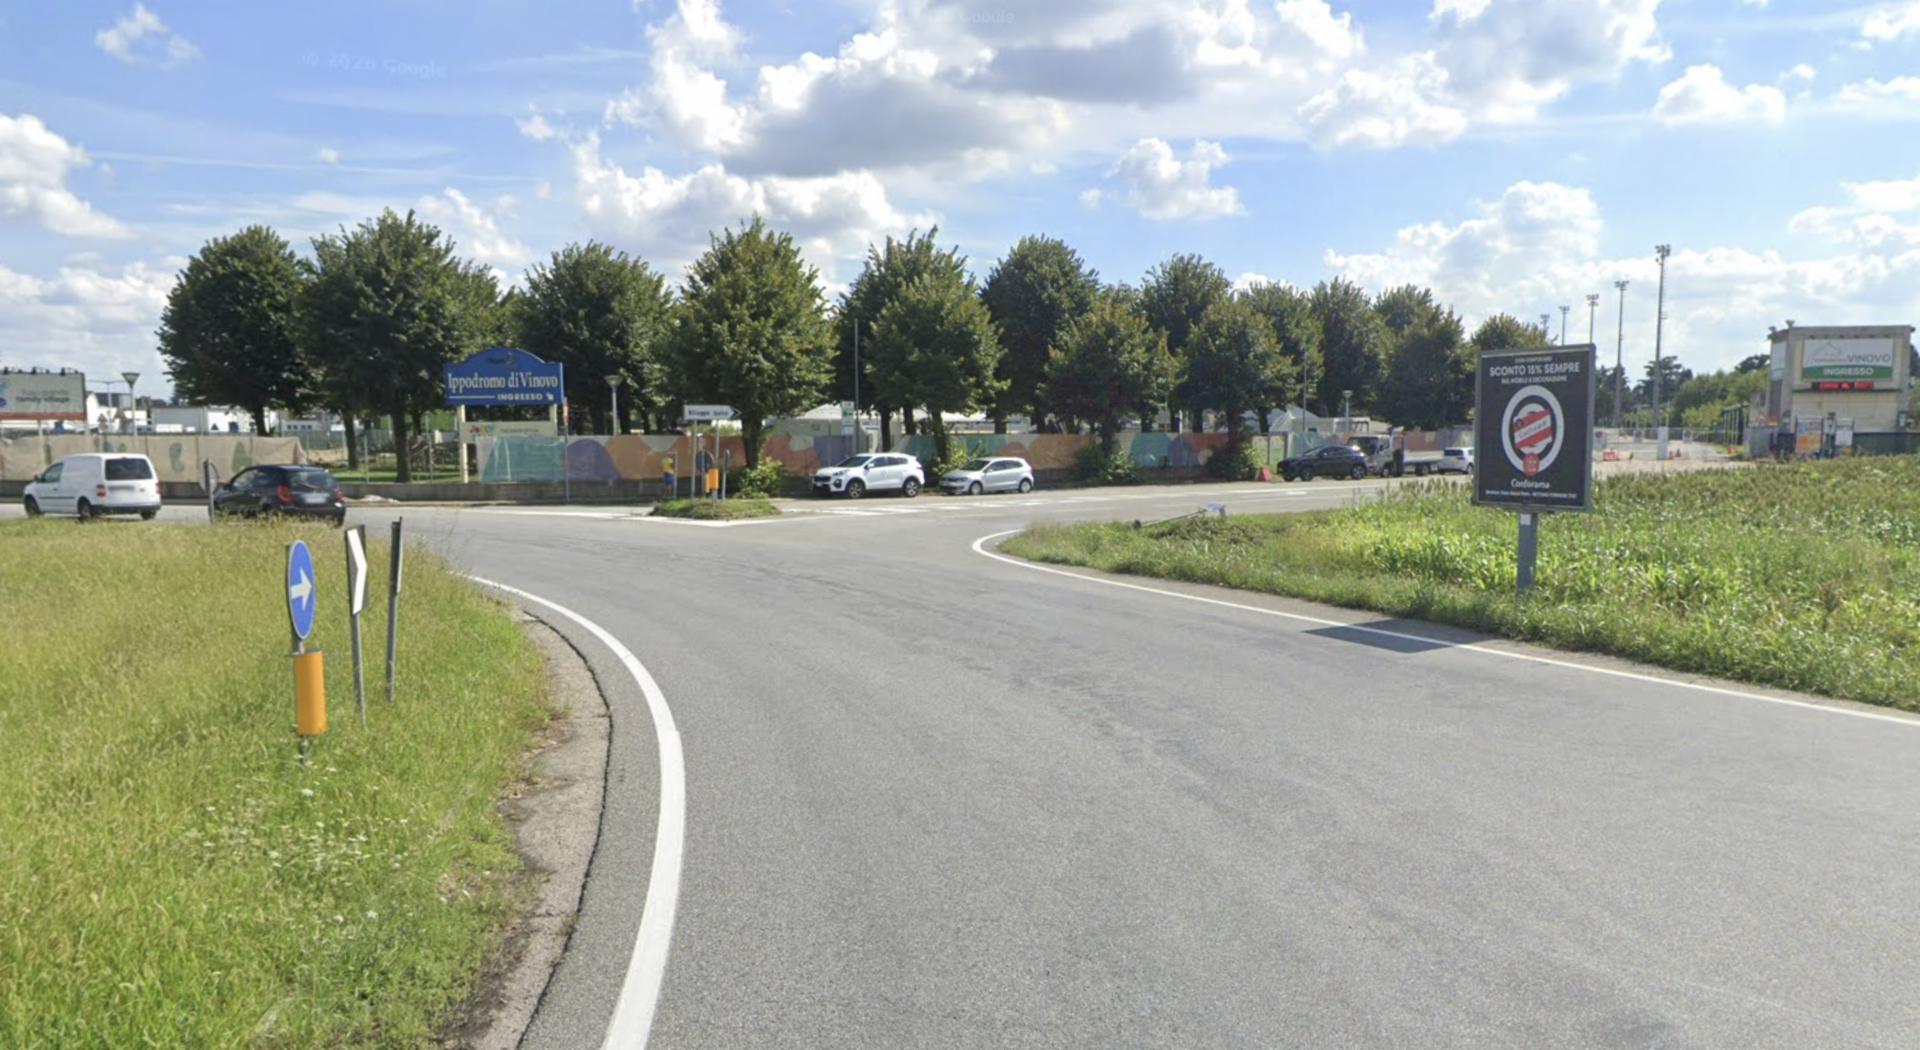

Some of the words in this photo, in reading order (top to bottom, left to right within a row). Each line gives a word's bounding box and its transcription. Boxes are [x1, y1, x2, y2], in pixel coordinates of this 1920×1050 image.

[1847, 352, 1891, 363] VINOVO
[1489, 364, 1526, 377] SCONTO
[1527, 363, 1542, 375] 15%
[1544, 361, 1580, 374] SEMPRE
[1823, 367, 1874, 376] INGRESSO
[448, 371, 505, 393] Ippodromo
[507, 371, 519, 388] di
[520, 371, 559, 388] Vinovo
[497, 392, 543, 401] INGRESSO
[1511, 478, 1550, 489] Conforama
